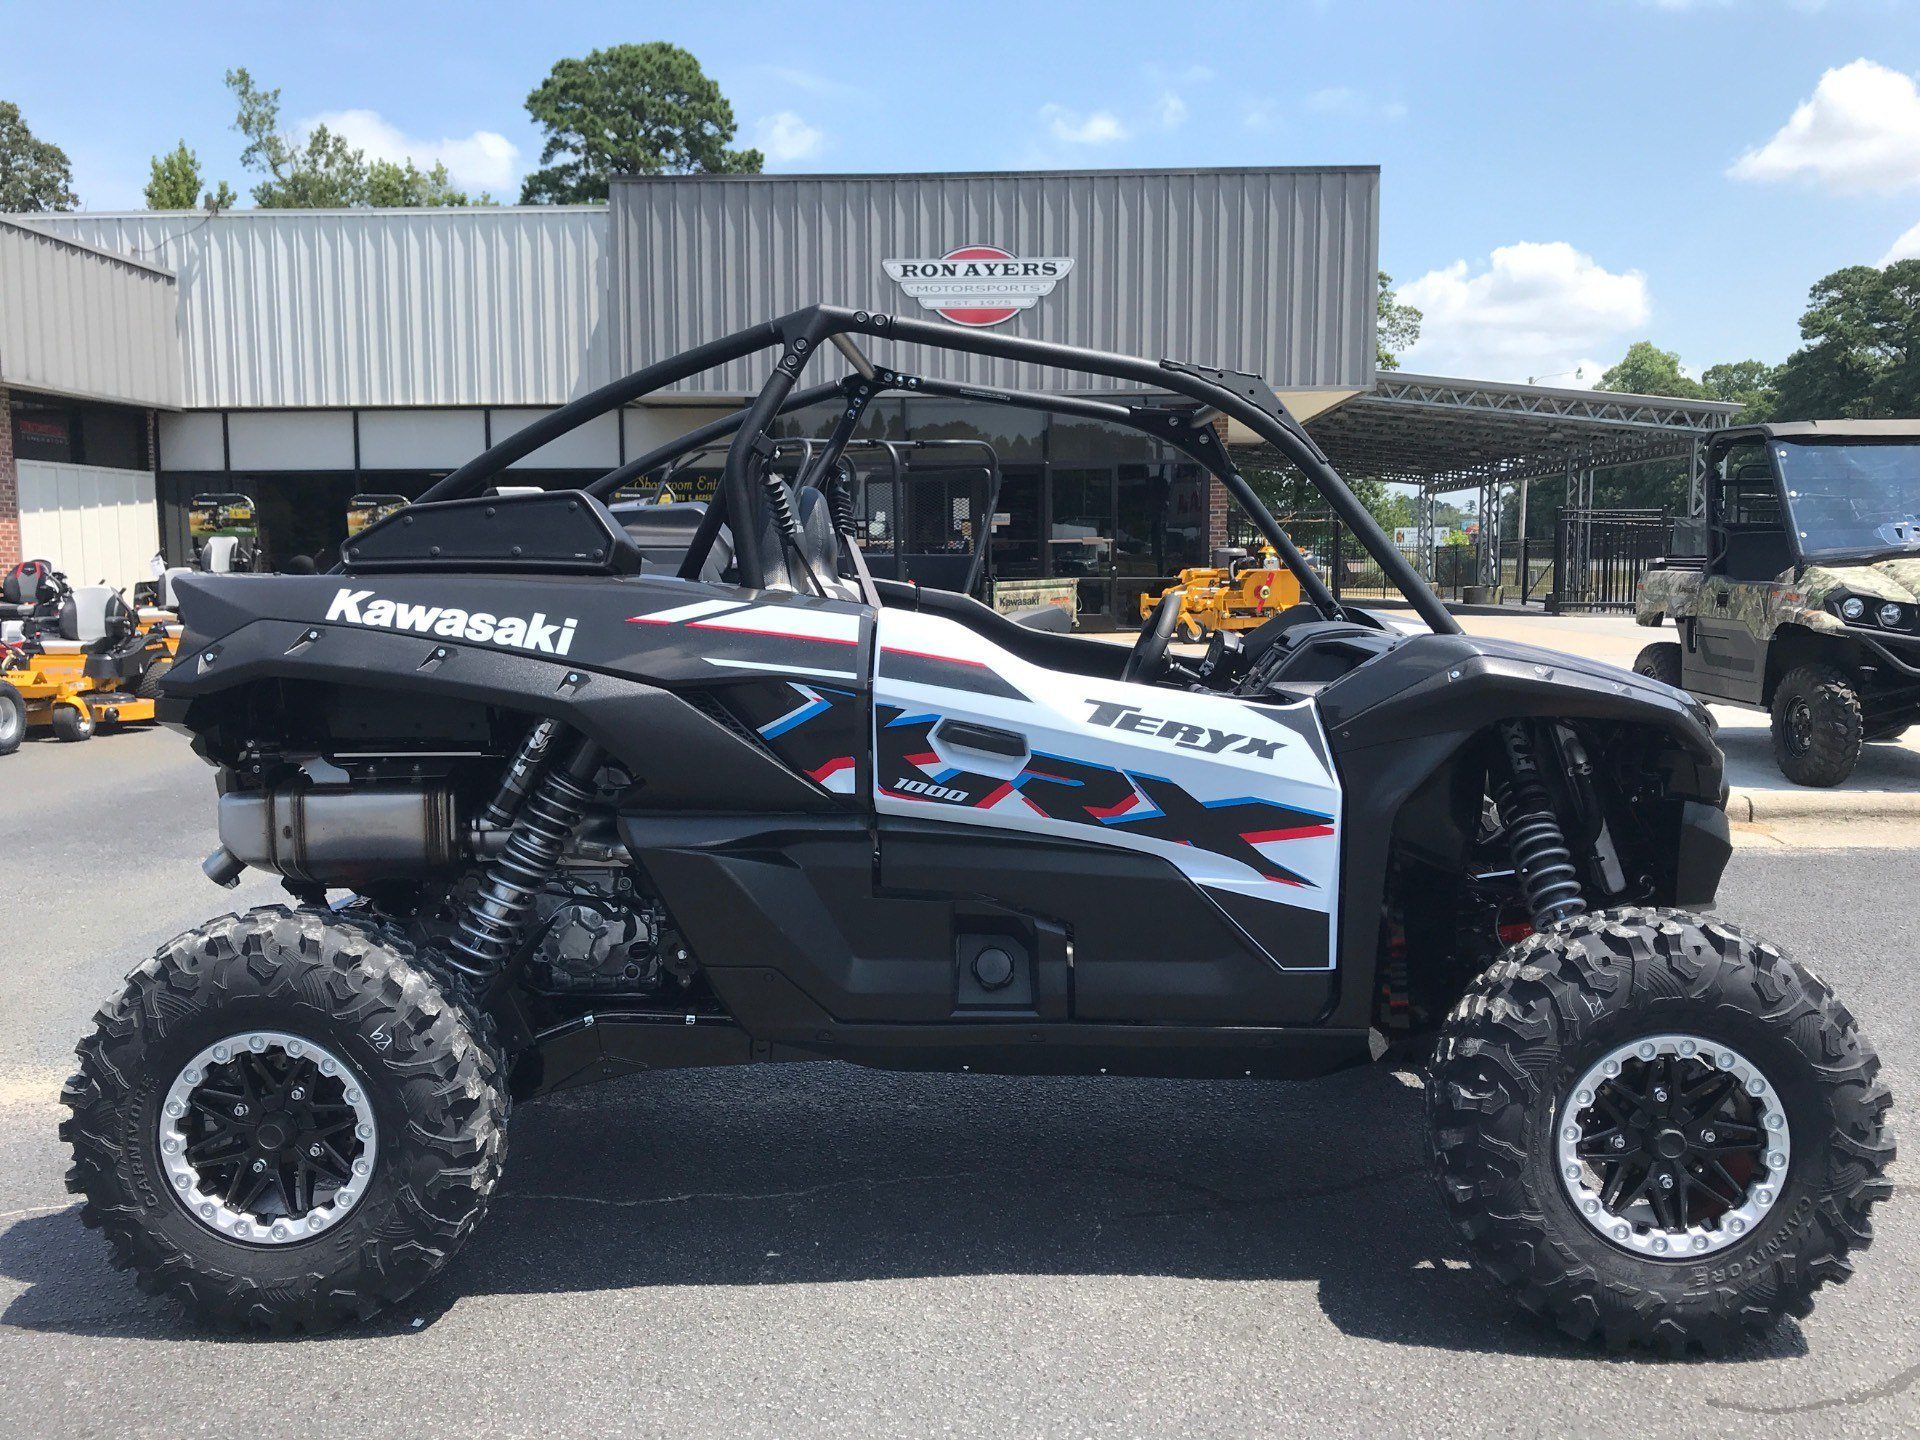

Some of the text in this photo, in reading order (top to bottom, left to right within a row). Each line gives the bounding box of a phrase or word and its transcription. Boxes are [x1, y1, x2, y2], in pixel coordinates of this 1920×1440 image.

[900, 261, 1058, 278] RON AYERS
[915, 283, 1041, 293] MOTORSPORTS
[634, 475, 692, 490] Shoroom
[999, 595, 1041, 607] Kawasaki
[325, 588, 579, 656] Kawasaki
[1084, 698, 1288, 760] TERYX
[893, 777, 970, 802] 1000
[1693, 1196, 1813, 1287] CARNIVORE
